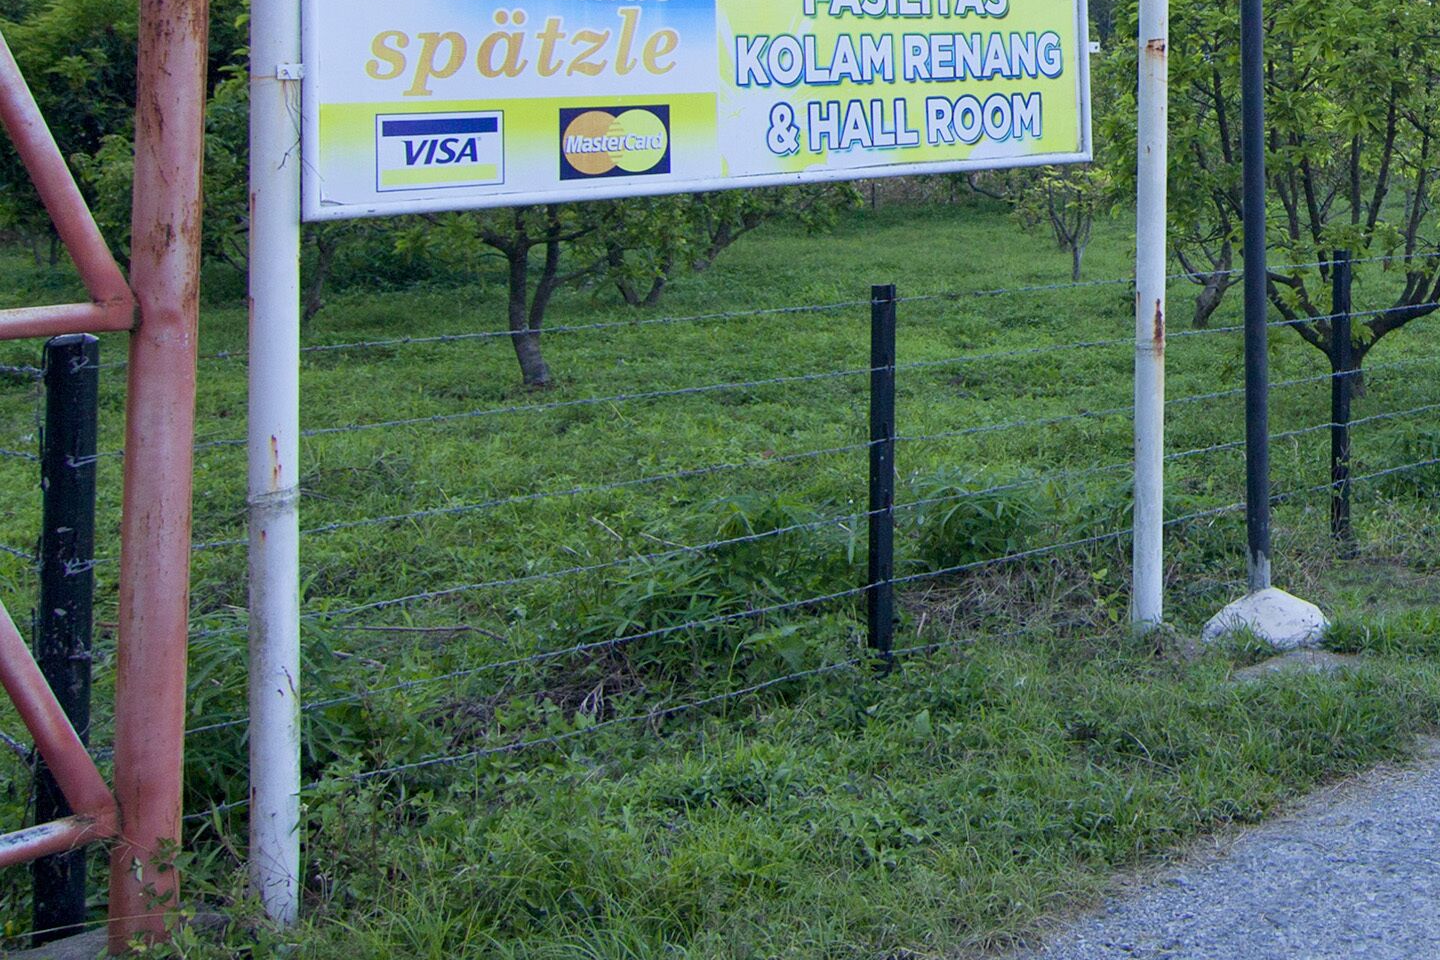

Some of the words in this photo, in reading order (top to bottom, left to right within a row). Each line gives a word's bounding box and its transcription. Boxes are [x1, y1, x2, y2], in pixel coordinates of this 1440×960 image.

[365, 7, 679, 97] spätzle
[736, 34, 895, 86] KOLAM
[903, 31, 1064, 81] RENANG
[565, 132, 663, 155] MasterCard
[766, 101, 800, 155] &
[808, 97, 920, 152] HALL
[925, 92, 1042, 145] ROOM
[401, 137, 479, 166] VISA
